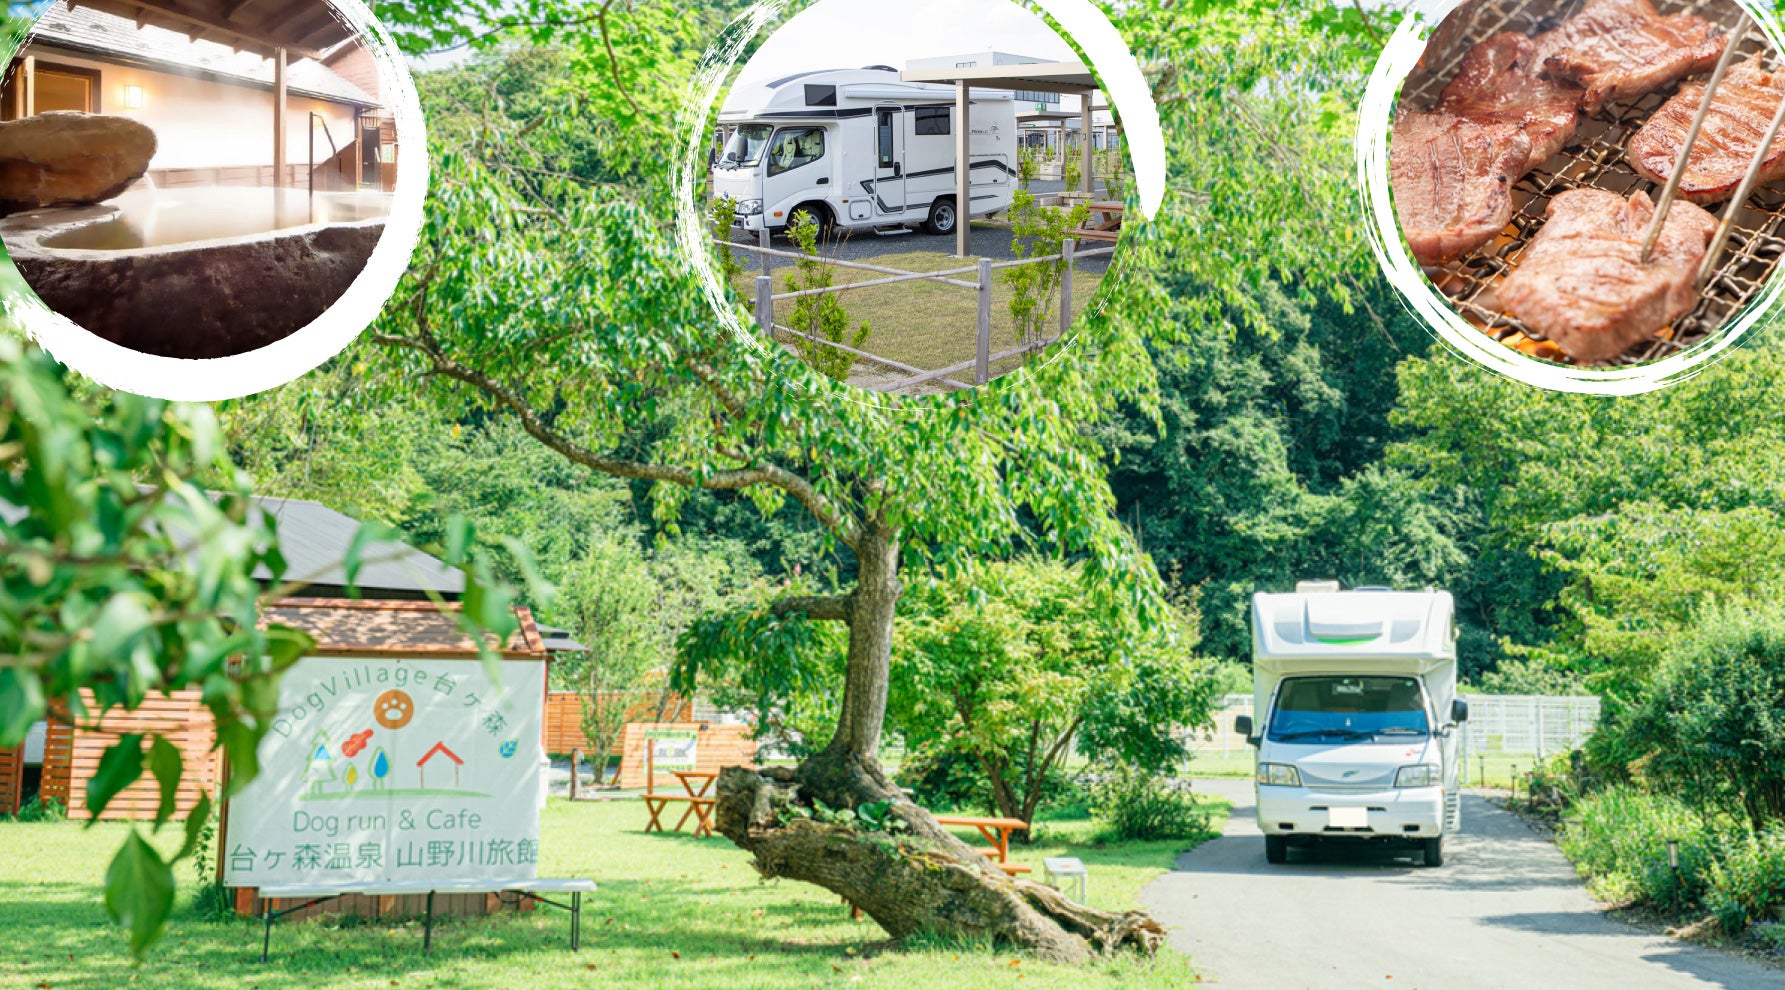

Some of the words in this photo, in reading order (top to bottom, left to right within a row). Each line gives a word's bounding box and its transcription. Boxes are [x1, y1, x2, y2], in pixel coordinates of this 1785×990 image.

[293, 810, 339, 837] Dog
[347, 814, 386, 831] run
[398, 809, 416, 830] &
[426, 808, 482, 830] Cafe
